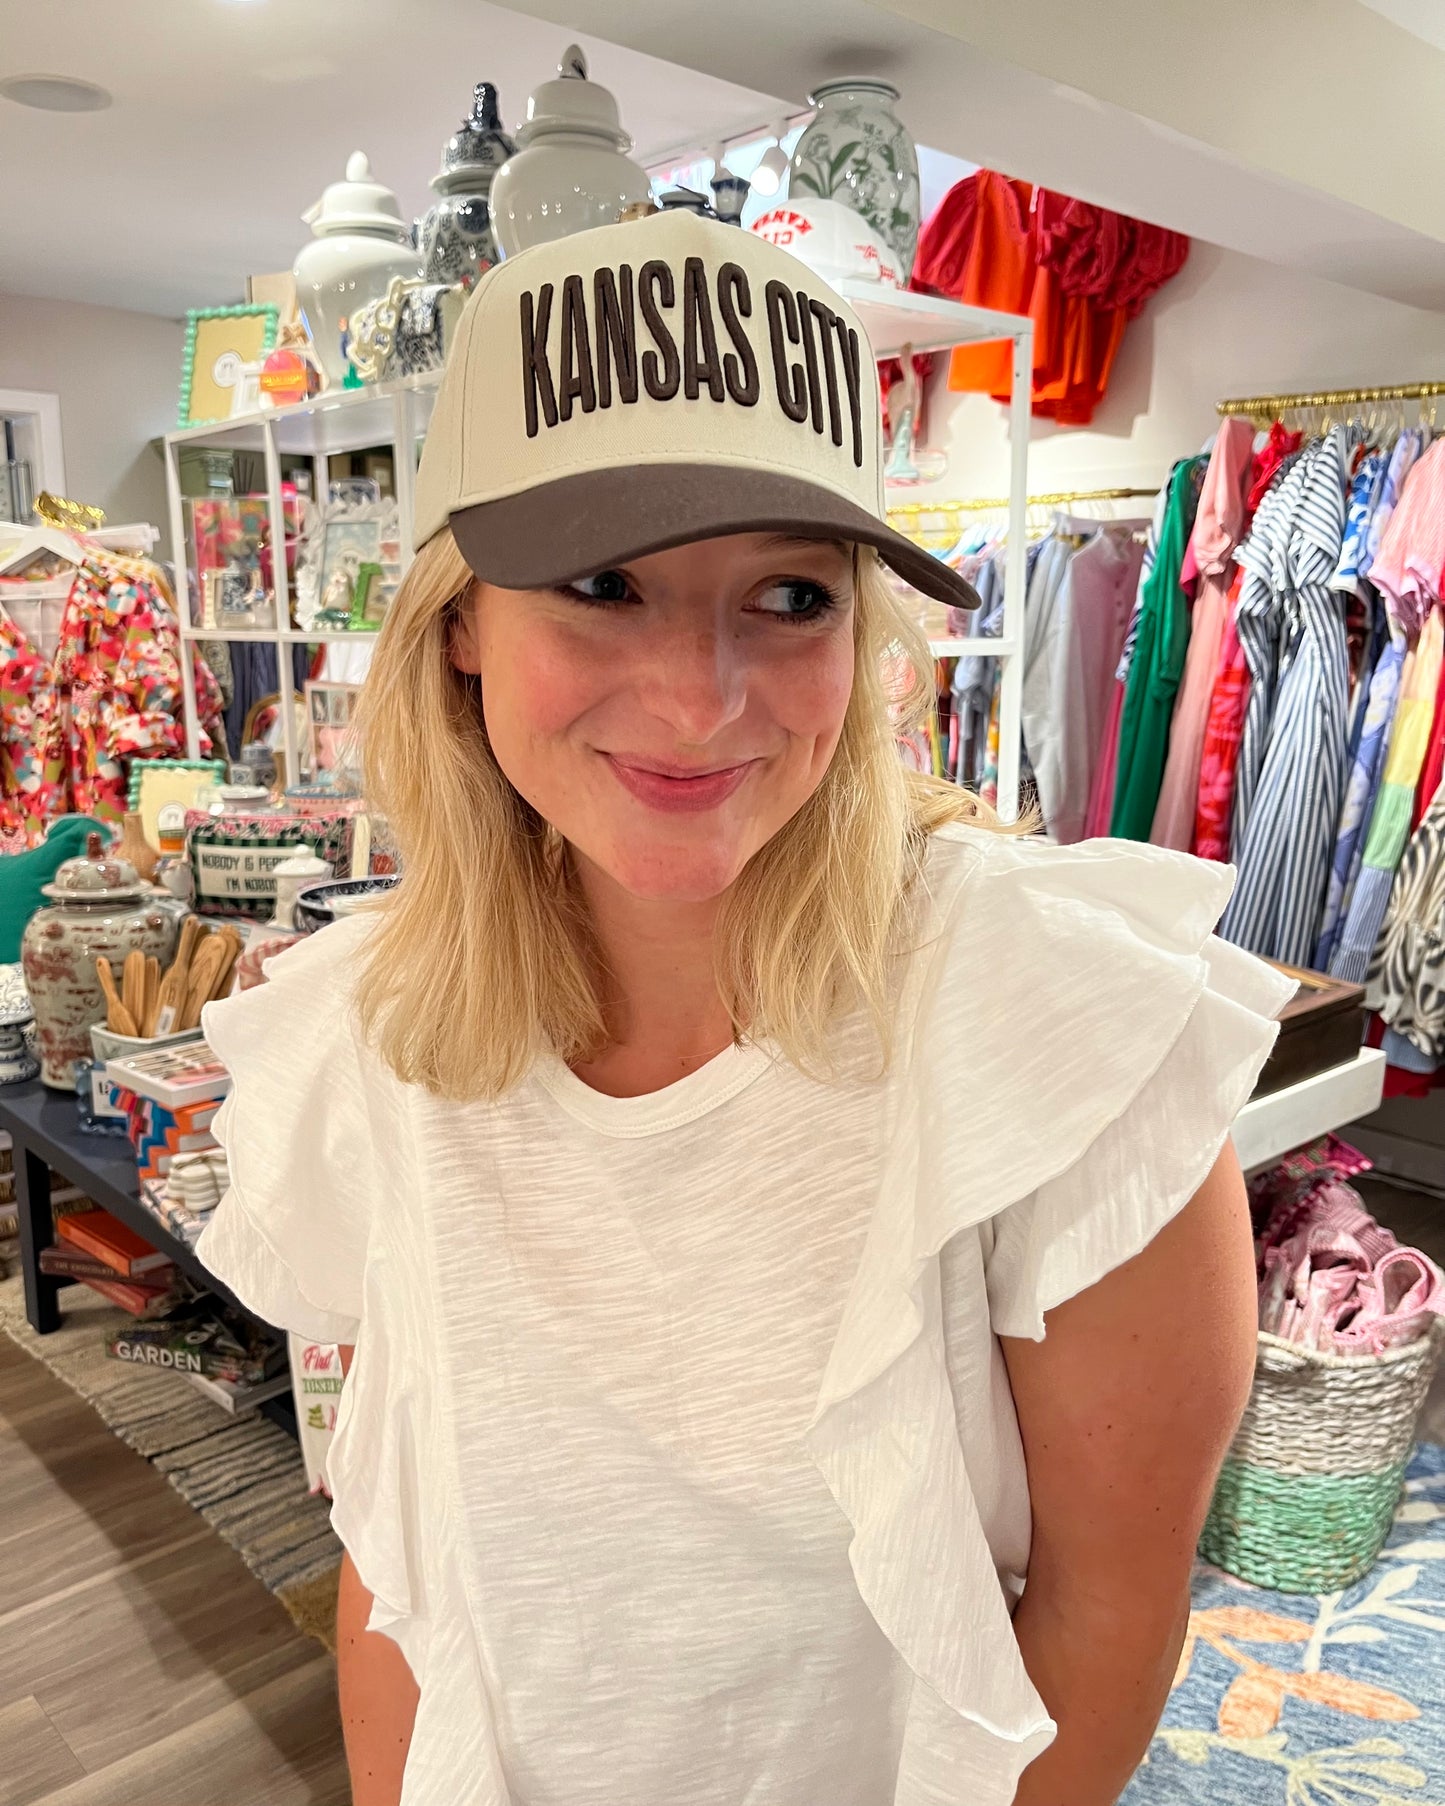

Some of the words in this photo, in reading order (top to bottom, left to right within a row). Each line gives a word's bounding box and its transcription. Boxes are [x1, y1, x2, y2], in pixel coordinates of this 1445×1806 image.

[520, 256, 760, 438] KANSAS
[765, 279, 862, 467] CITY
[201, 853, 240, 871] NOBODY
[244, 855, 255, 872] IS
[226, 877, 240, 892] I'M
[244, 878, 278, 892] NOBOD
[115, 1340, 201, 1373] GARDEN
